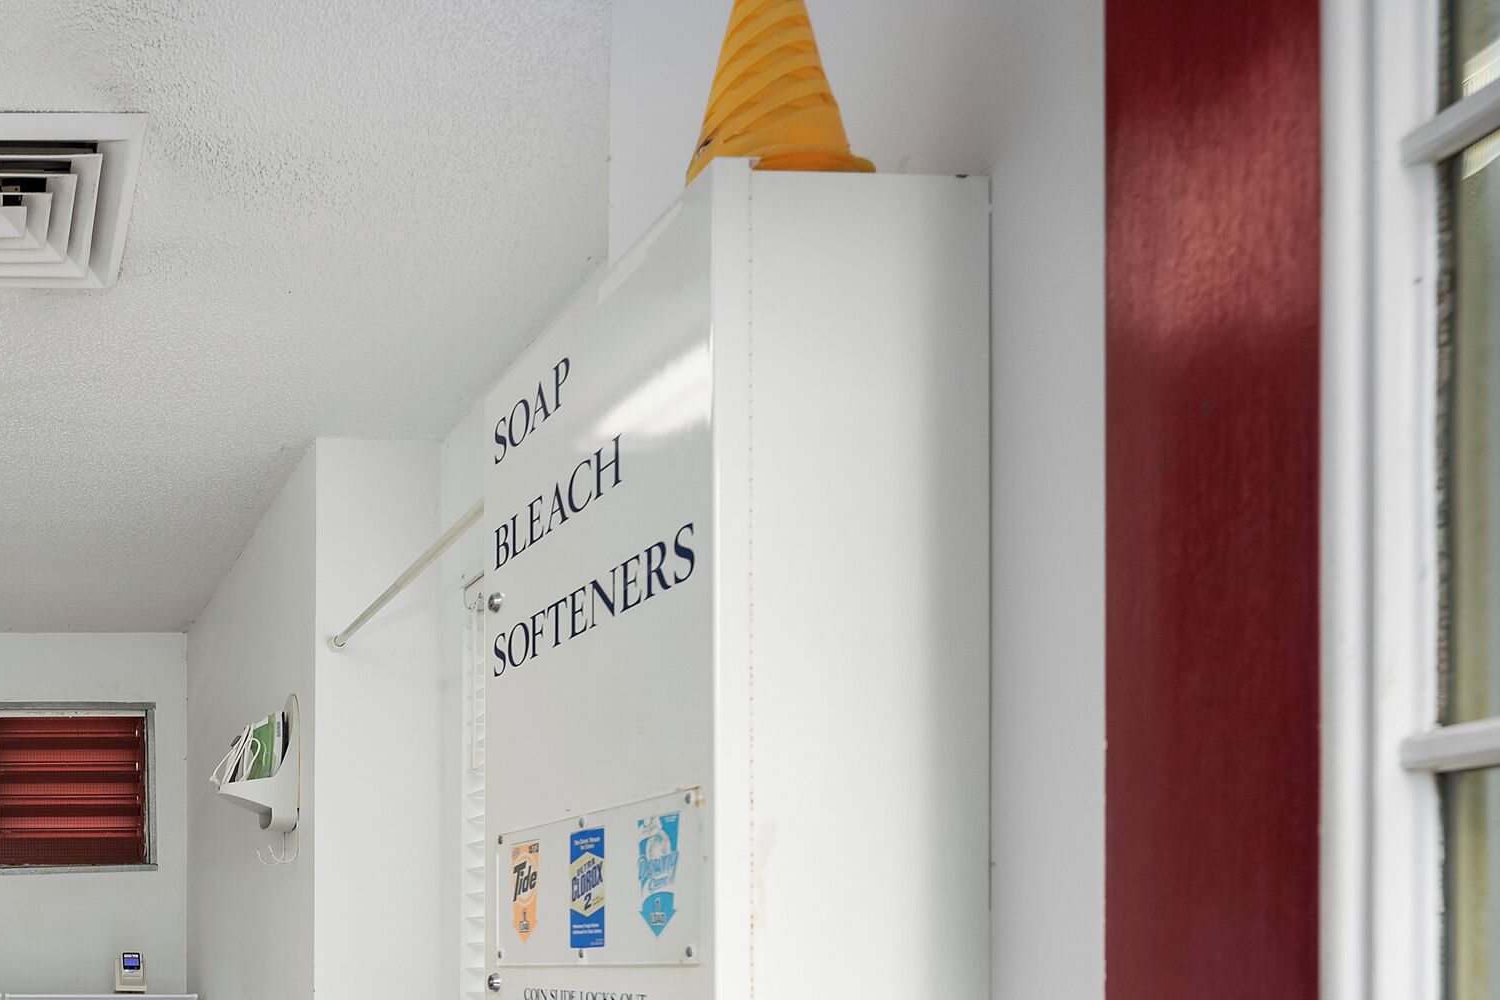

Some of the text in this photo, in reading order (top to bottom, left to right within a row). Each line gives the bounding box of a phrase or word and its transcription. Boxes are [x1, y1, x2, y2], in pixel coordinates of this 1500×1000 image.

[494, 357, 570, 465] SOAP
[494, 432, 622, 571] BLEACH
[493, 521, 695, 678] SOFTENERS
[513, 860, 538, 902] Tide
[572, 861, 603, 902] CLOROX
[577, 858, 596, 877] ULTRA
[637, 850, 679, 881] Downy
[584, 892, 592, 911] 2
